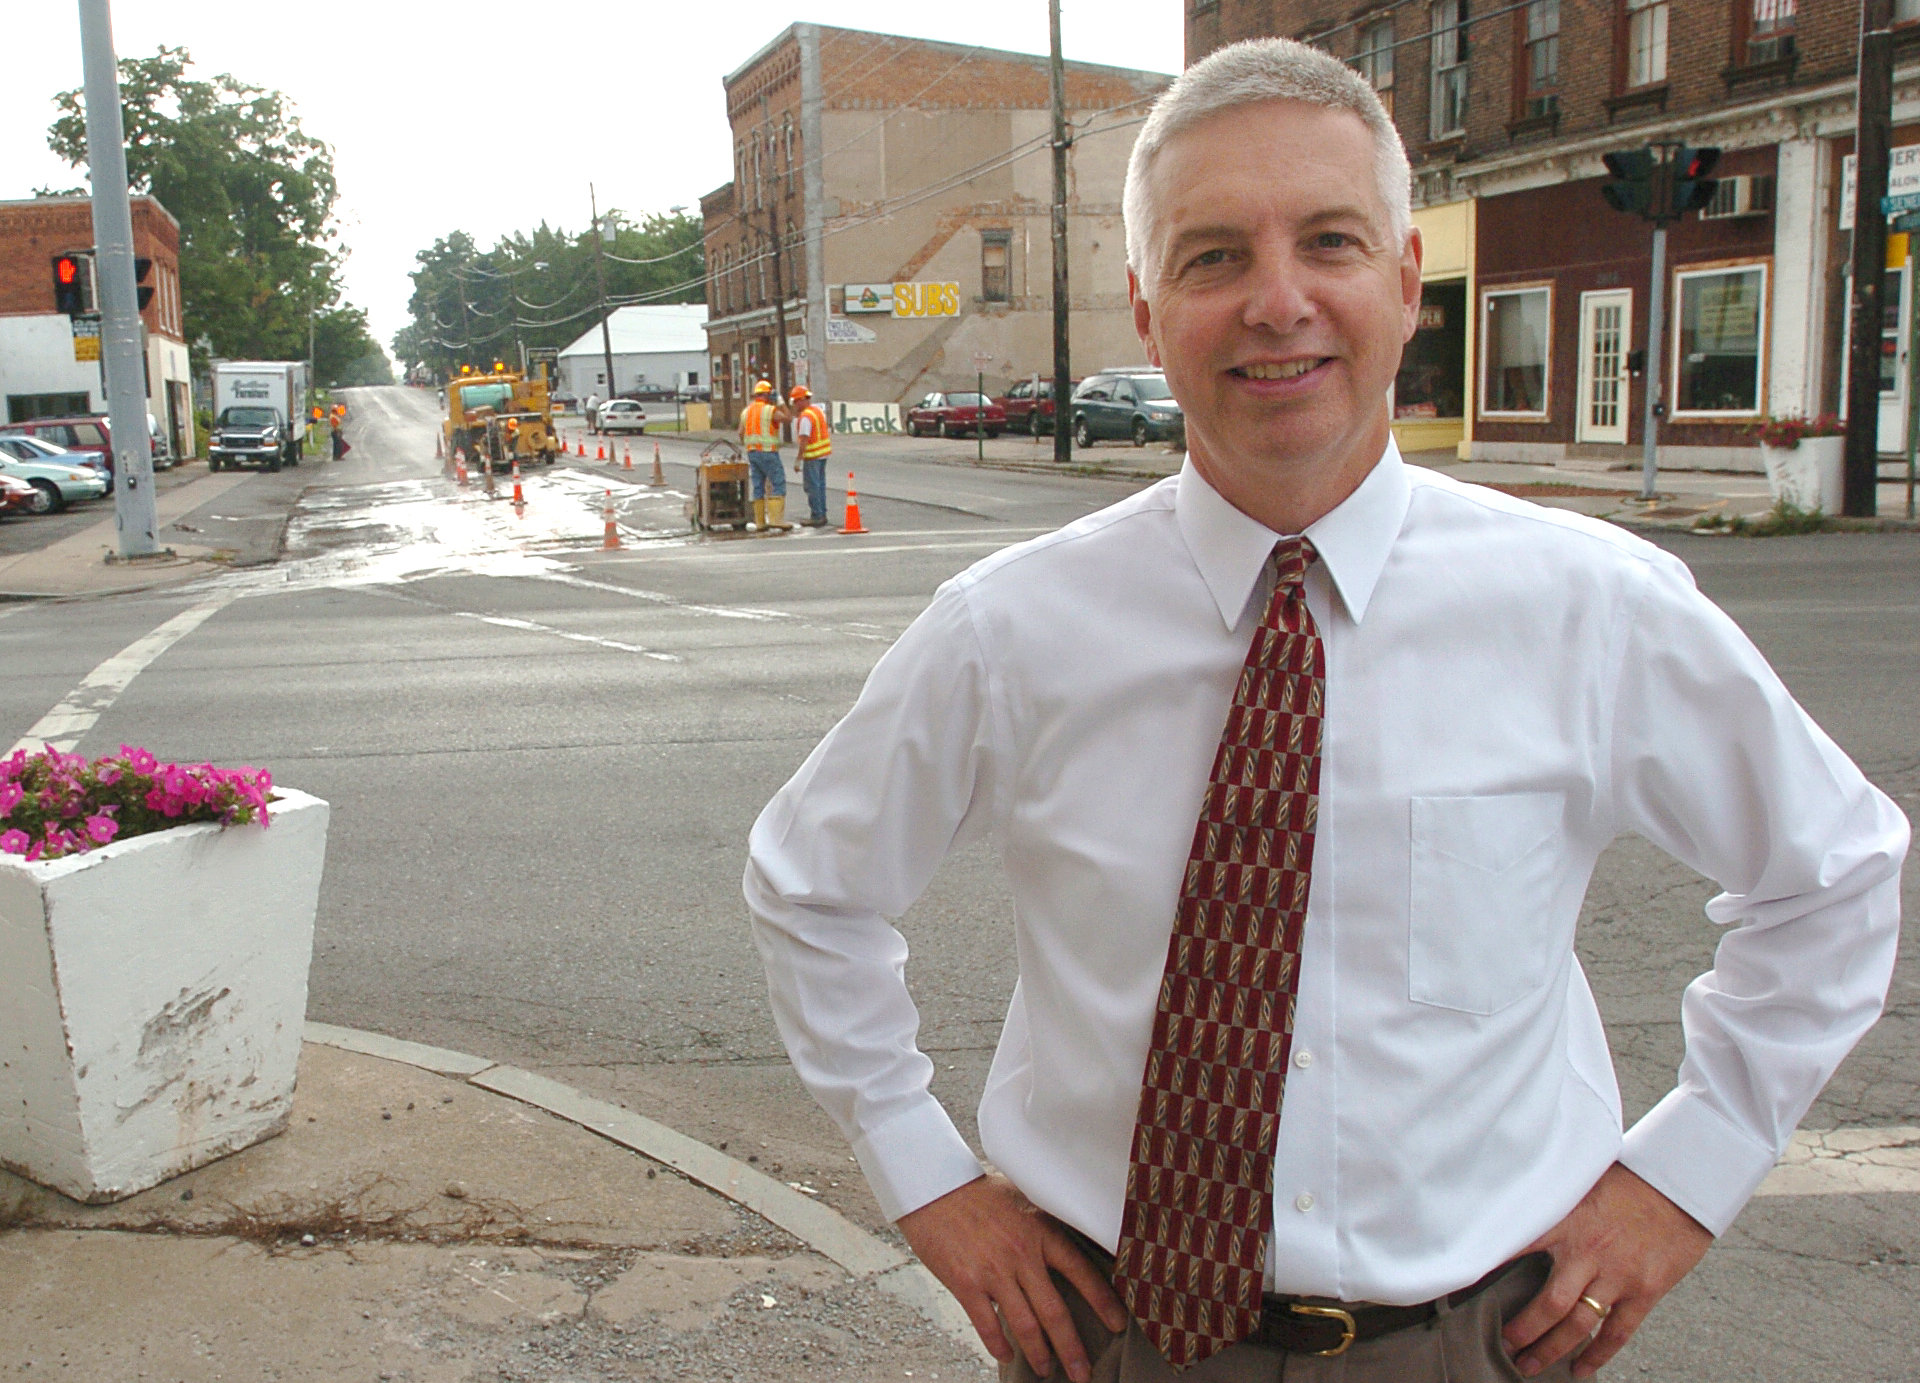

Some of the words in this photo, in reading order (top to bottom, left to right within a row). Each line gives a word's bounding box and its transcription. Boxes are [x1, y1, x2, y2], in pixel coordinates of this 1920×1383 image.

[1890, 194, 1920, 211] SENE
[894, 283, 959, 317] SUBS
[791, 349, 807, 360] 30
